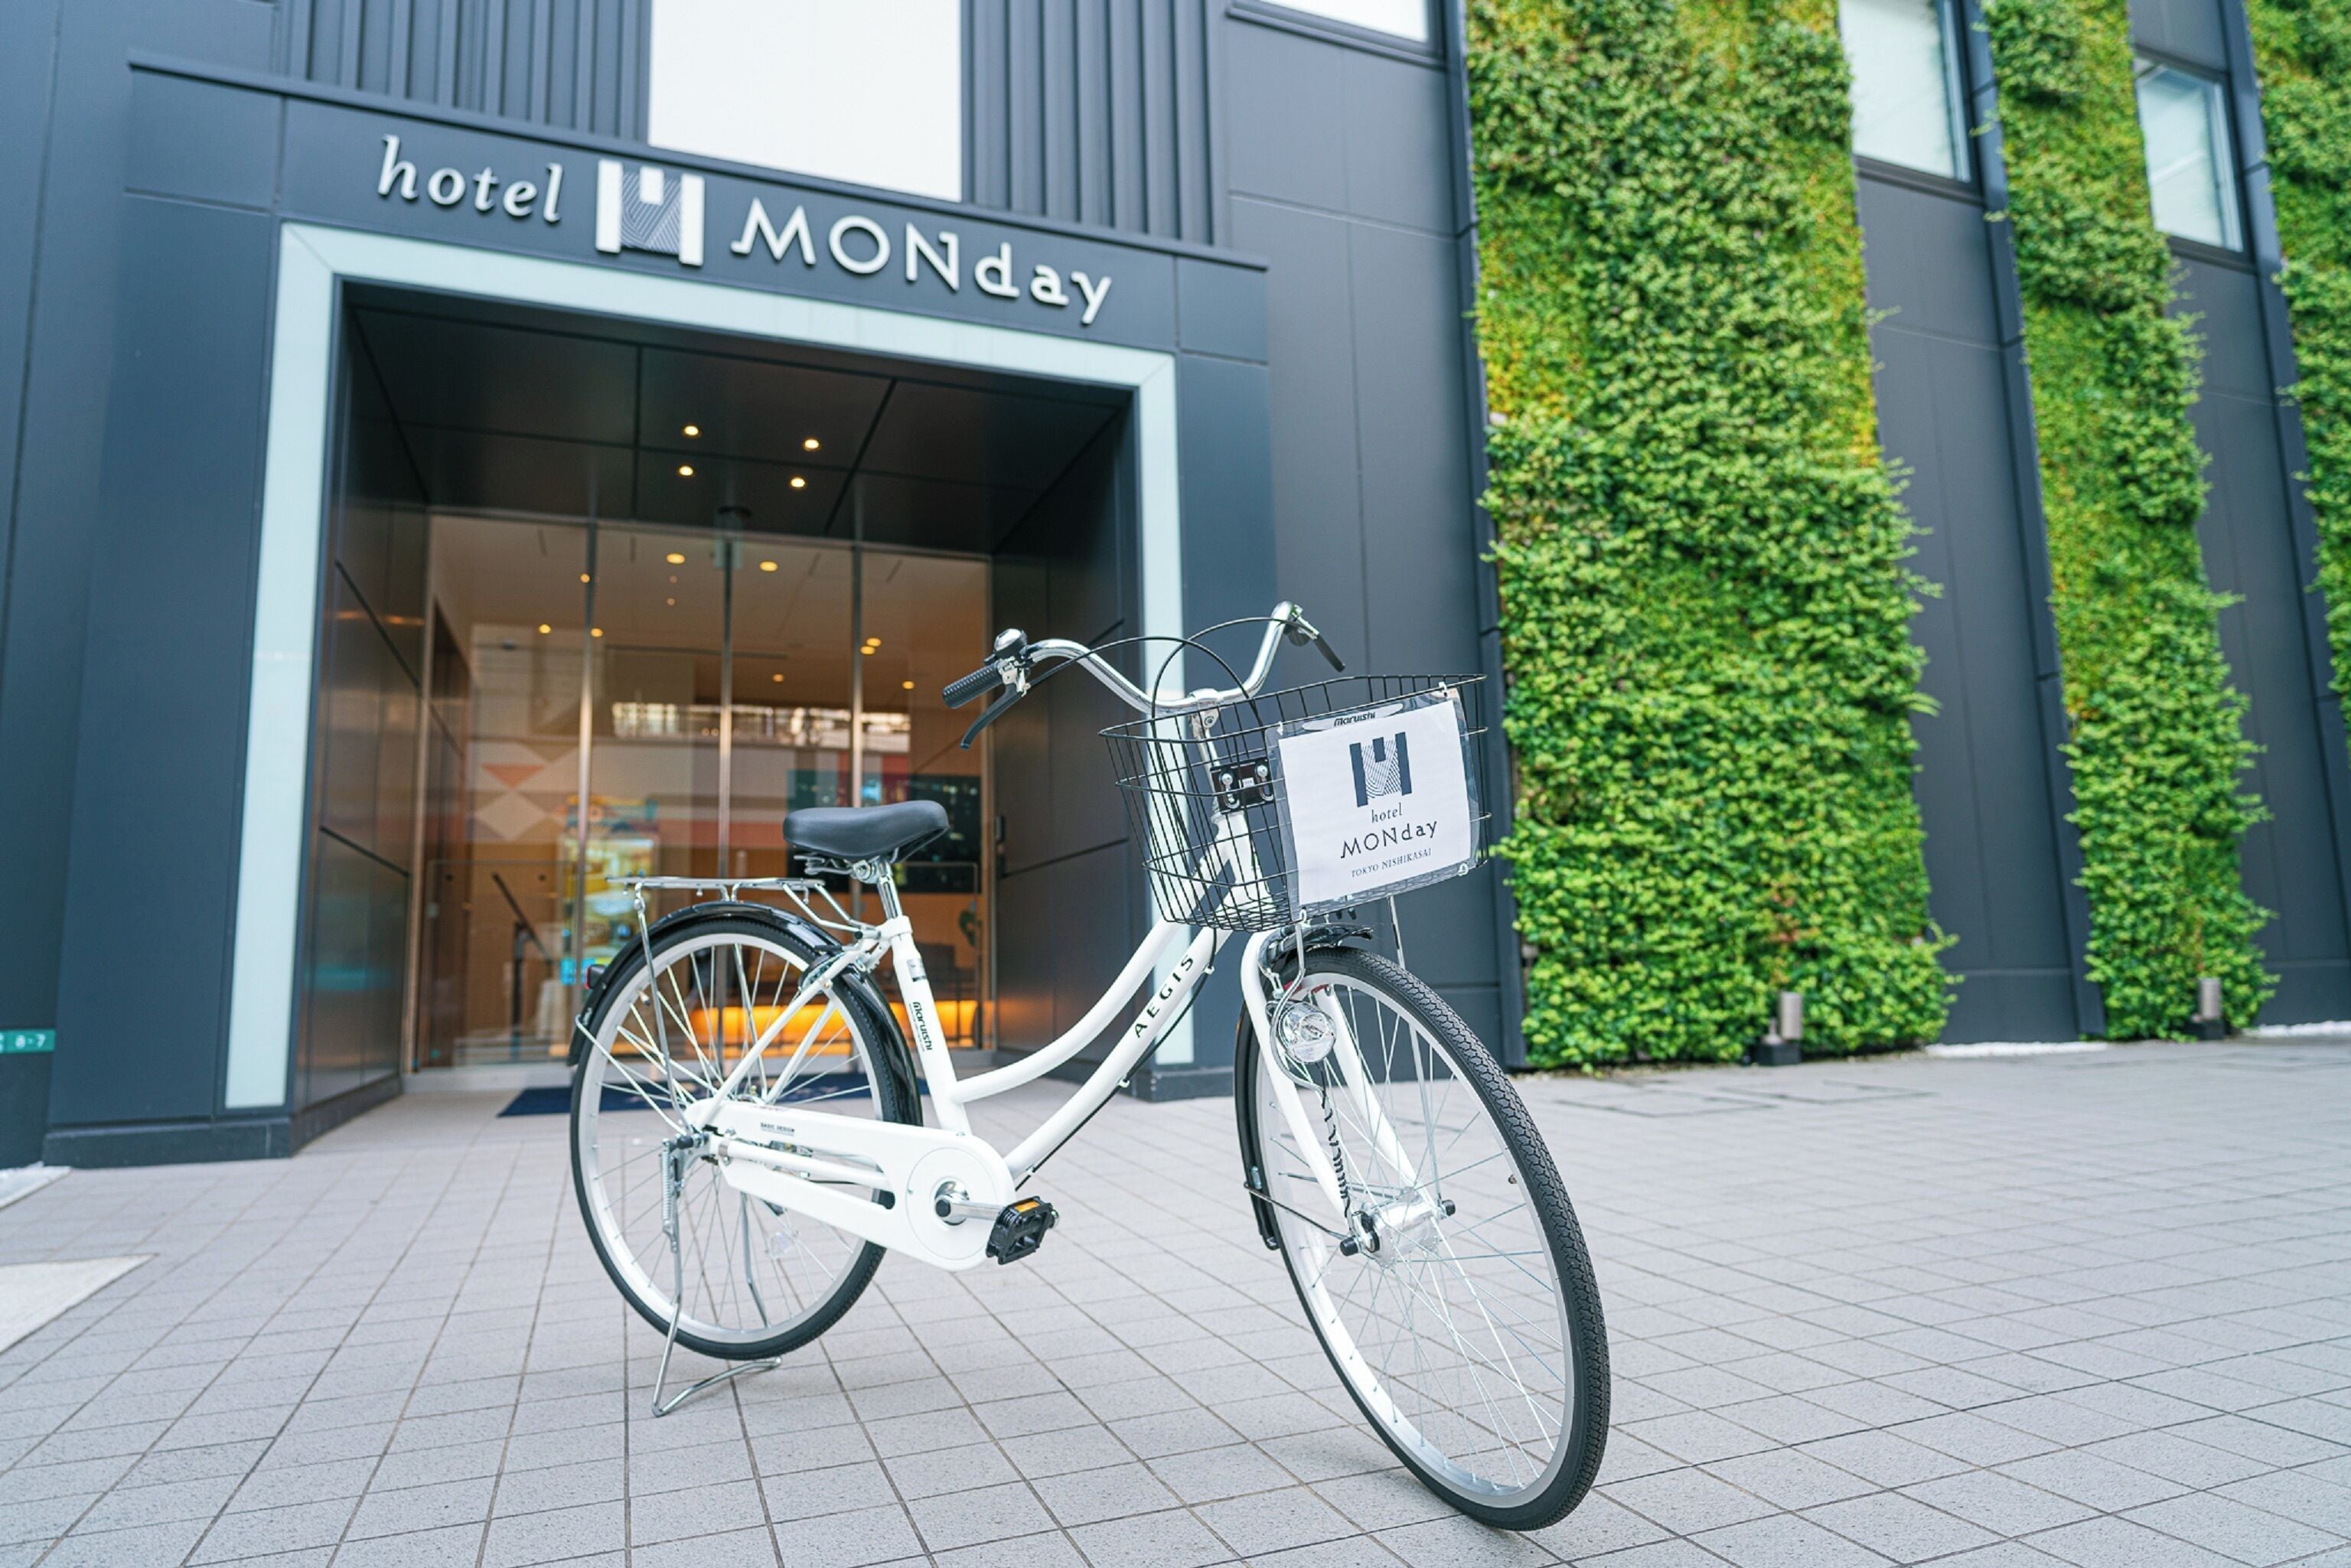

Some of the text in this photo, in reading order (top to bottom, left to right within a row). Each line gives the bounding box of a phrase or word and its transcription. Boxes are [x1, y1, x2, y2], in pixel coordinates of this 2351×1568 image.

[378, 135, 1112, 326] hotel MONday
[1371, 802, 1402, 823] hotel
[1340, 820, 1437, 859] MONday
[1351, 847, 1431, 878] TOKYO NISHIKASAI
[1135, 954, 1194, 1038] AEGIS
